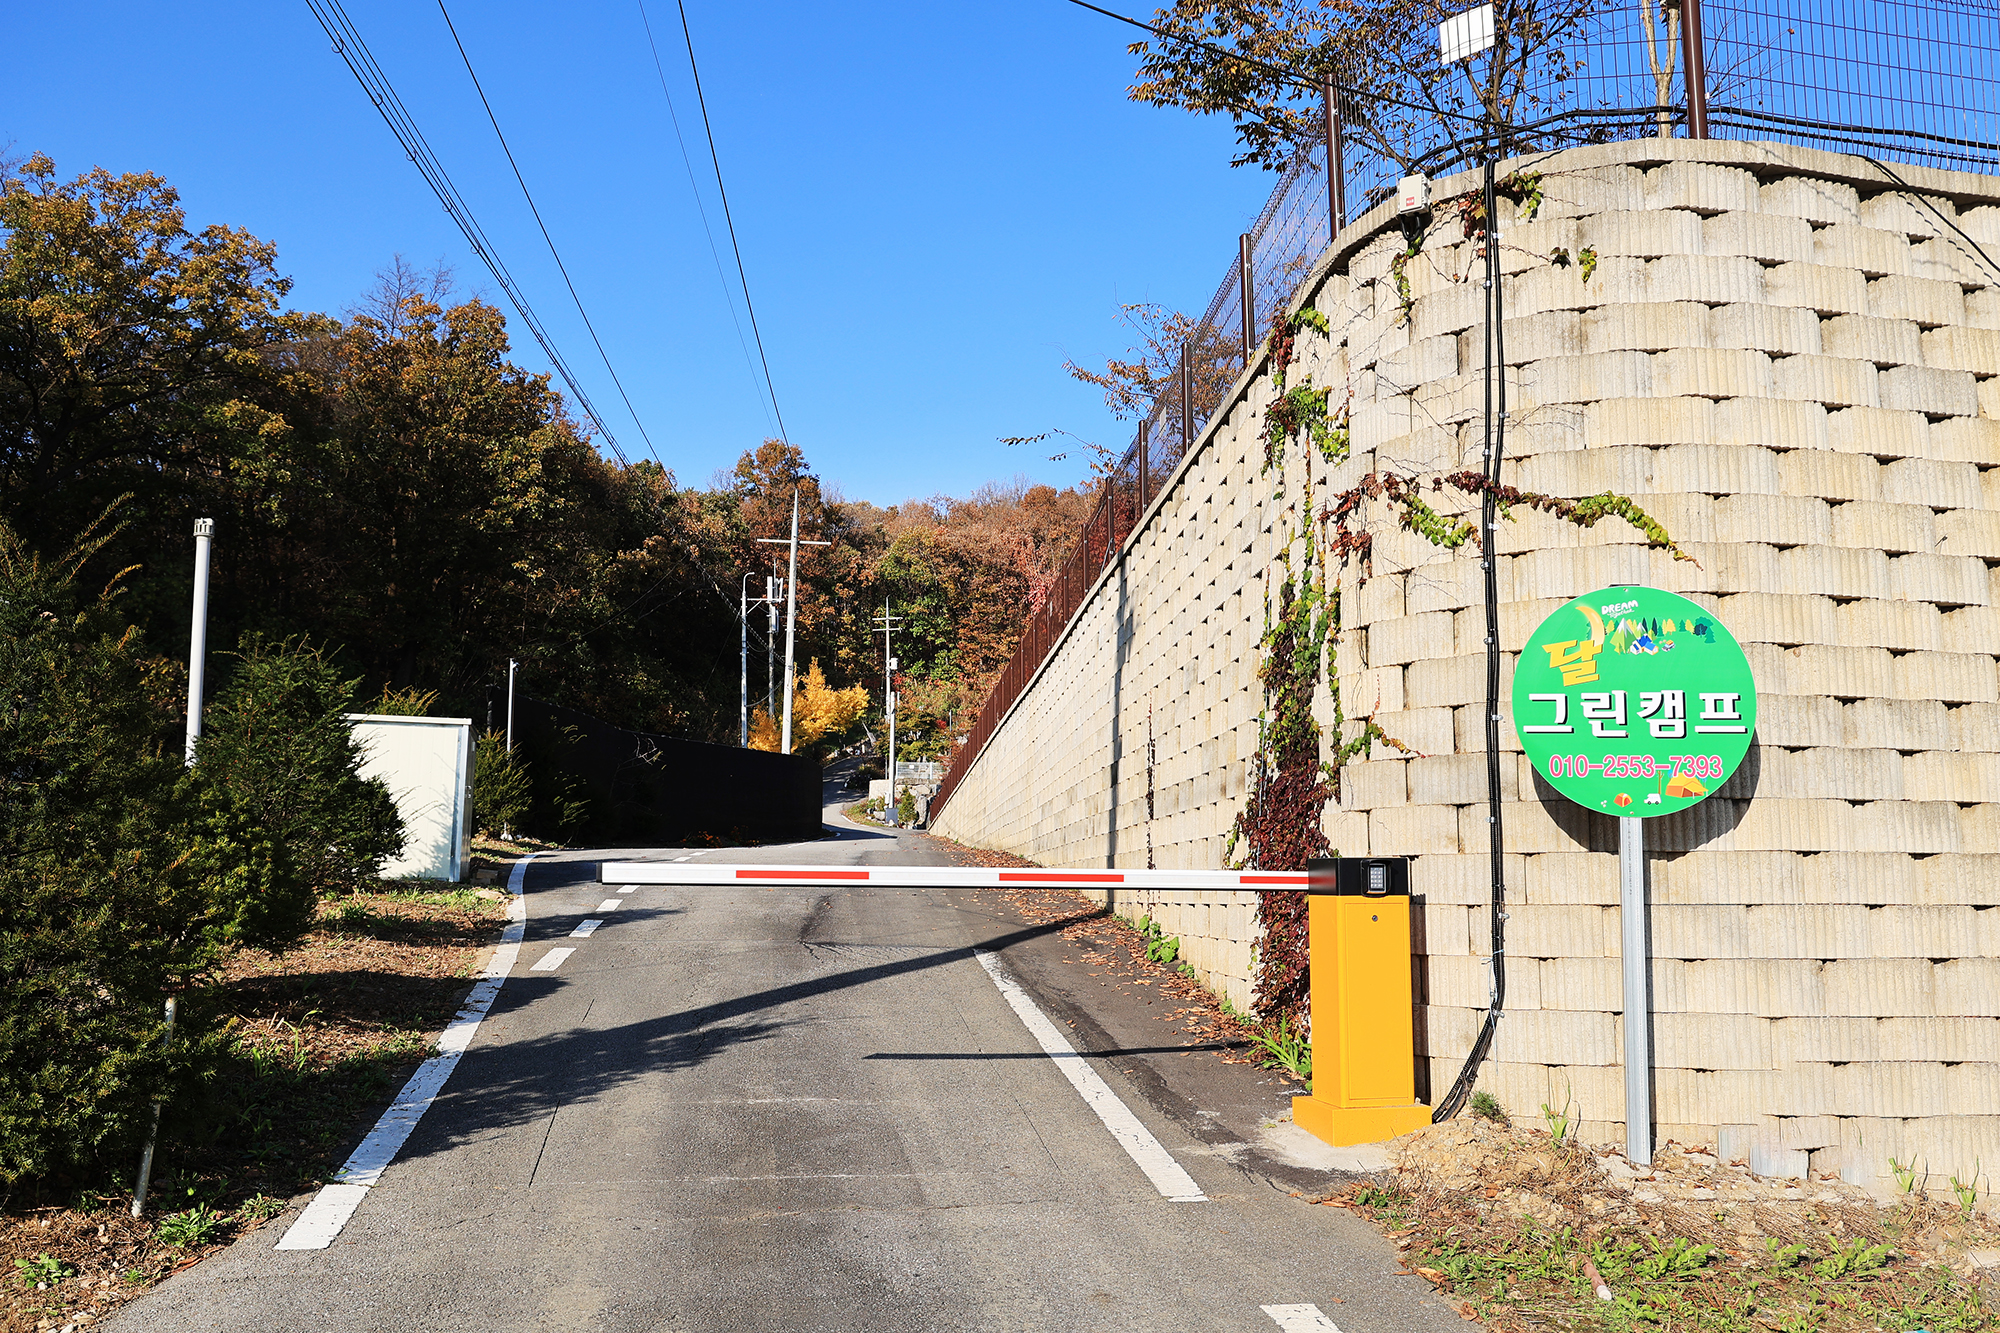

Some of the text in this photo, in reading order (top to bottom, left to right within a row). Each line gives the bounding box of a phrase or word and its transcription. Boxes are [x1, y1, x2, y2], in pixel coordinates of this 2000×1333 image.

[1601, 600, 1639, 615] DREAM
[1542, 639, 1603, 687] 달
[1549, 754, 1723, 779] 010-2553-7393
